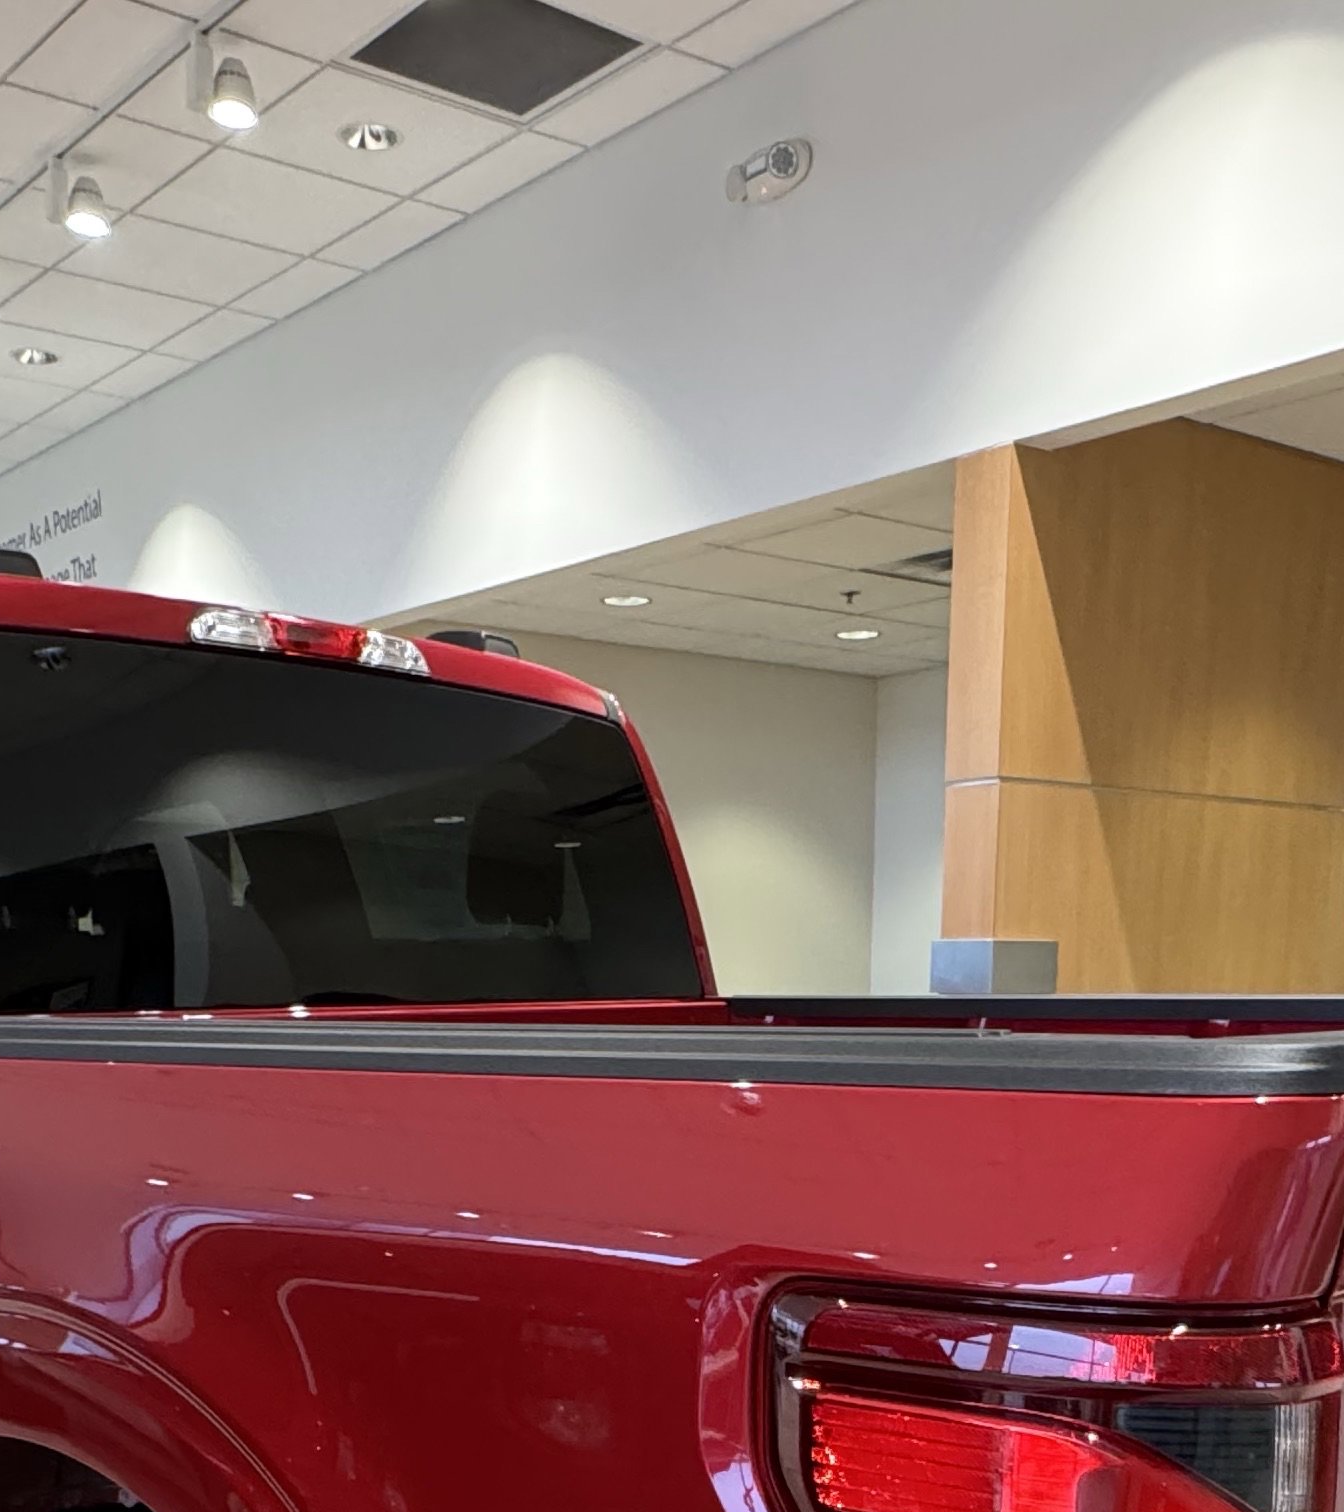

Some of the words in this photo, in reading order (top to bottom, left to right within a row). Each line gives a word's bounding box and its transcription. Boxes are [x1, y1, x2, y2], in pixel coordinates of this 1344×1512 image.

[29, 522, 42, 549] As
[43, 514, 52, 542] A
[52, 488, 102, 537] Potential
[69, 553, 97, 582] That
